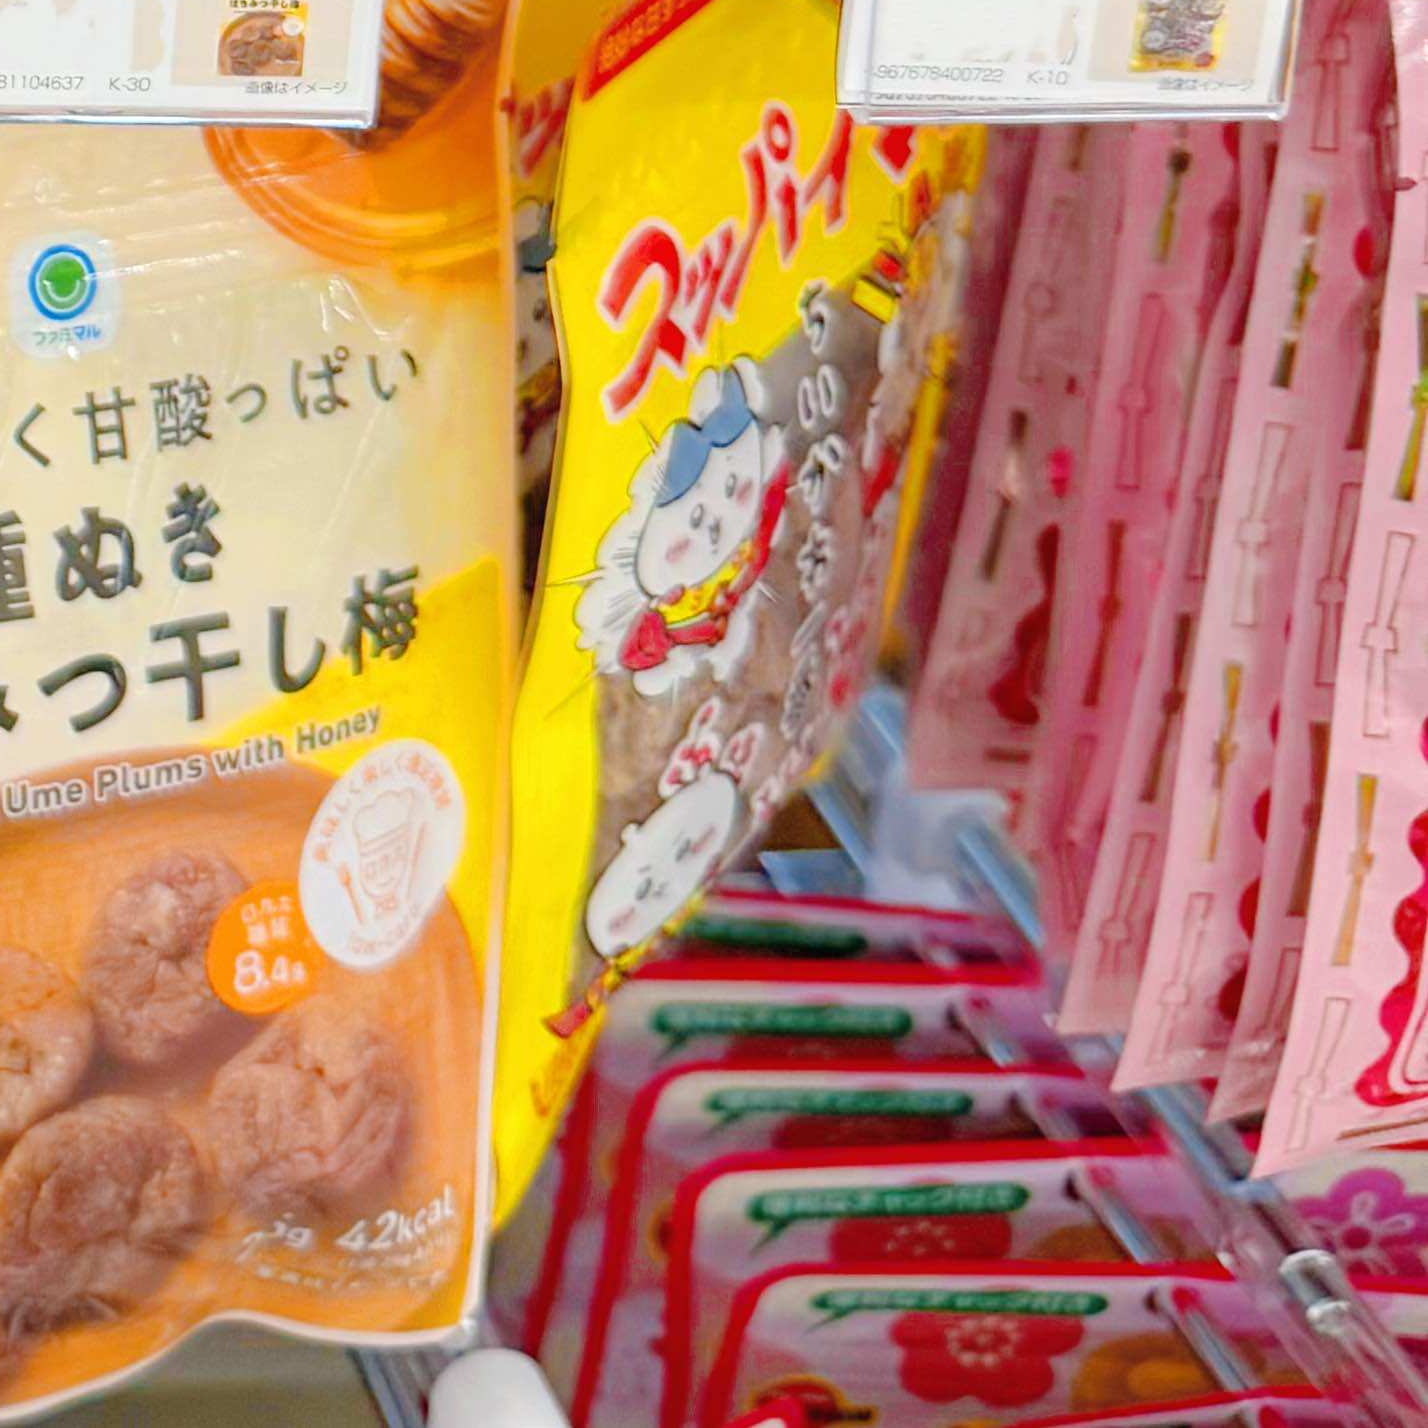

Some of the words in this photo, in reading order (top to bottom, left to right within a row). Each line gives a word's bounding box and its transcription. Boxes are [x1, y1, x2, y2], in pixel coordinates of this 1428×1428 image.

[108, 76, 152, 93] K-30
[873, 66, 1004, 84] 967678400722
[3, 776, 84, 816] Ume
[94, 753, 204, 802] Plums
[213, 734, 285, 777] with
[295, 704, 383, 755] Honey
[335, 1184, 456, 1252] 42kcal
